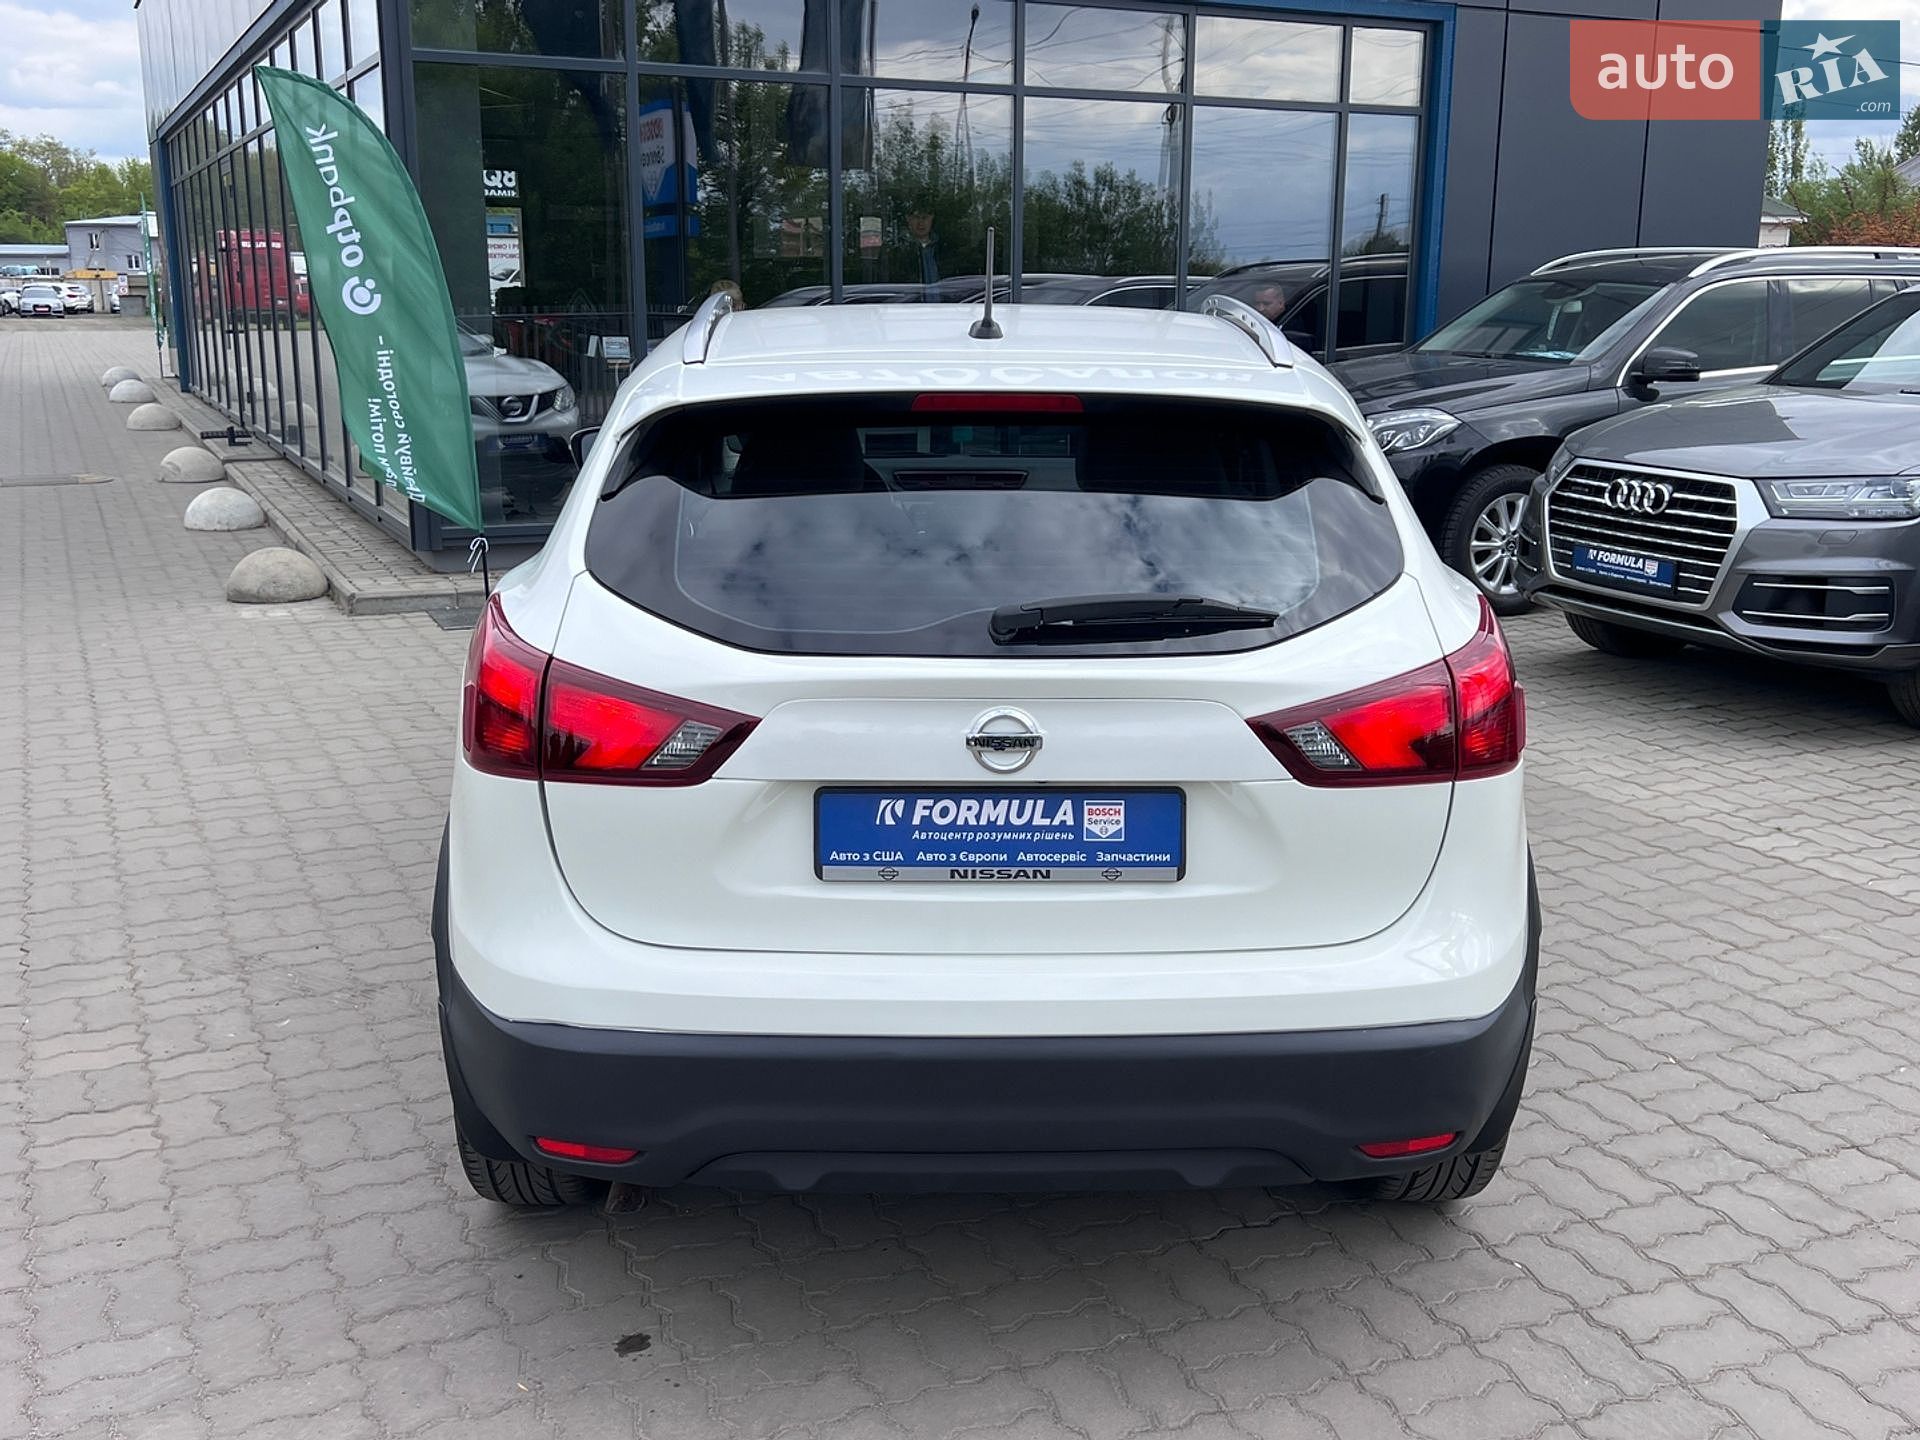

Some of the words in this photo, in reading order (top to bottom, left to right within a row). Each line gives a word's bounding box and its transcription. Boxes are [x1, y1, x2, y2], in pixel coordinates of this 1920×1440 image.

[1597, 551, 1644, 569] FORMULA
[973, 737, 1036, 750] NISSAN
[911, 798, 1075, 826] FORMULA
[1087, 807, 1121, 816] BOSCH
[1087, 817, 1121, 826] Service
[911, 830, 975, 842] Автоцентр
[976, 831, 1032, 843] розумних
[1033, 830, 1075, 843] рішень
[829, 851, 860, 862] Авто
[863, 853, 870, 862] з
[873, 851, 904, 862] США
[916, 851, 947, 862] Авто
[950, 853, 957, 862] з
[959, 851, 1008, 864] Європи
[1016, 851, 1087, 864] Автосервіс
[1096, 852, 1171, 863] Запчастини
[949, 869, 1051, 879] NISSAN
